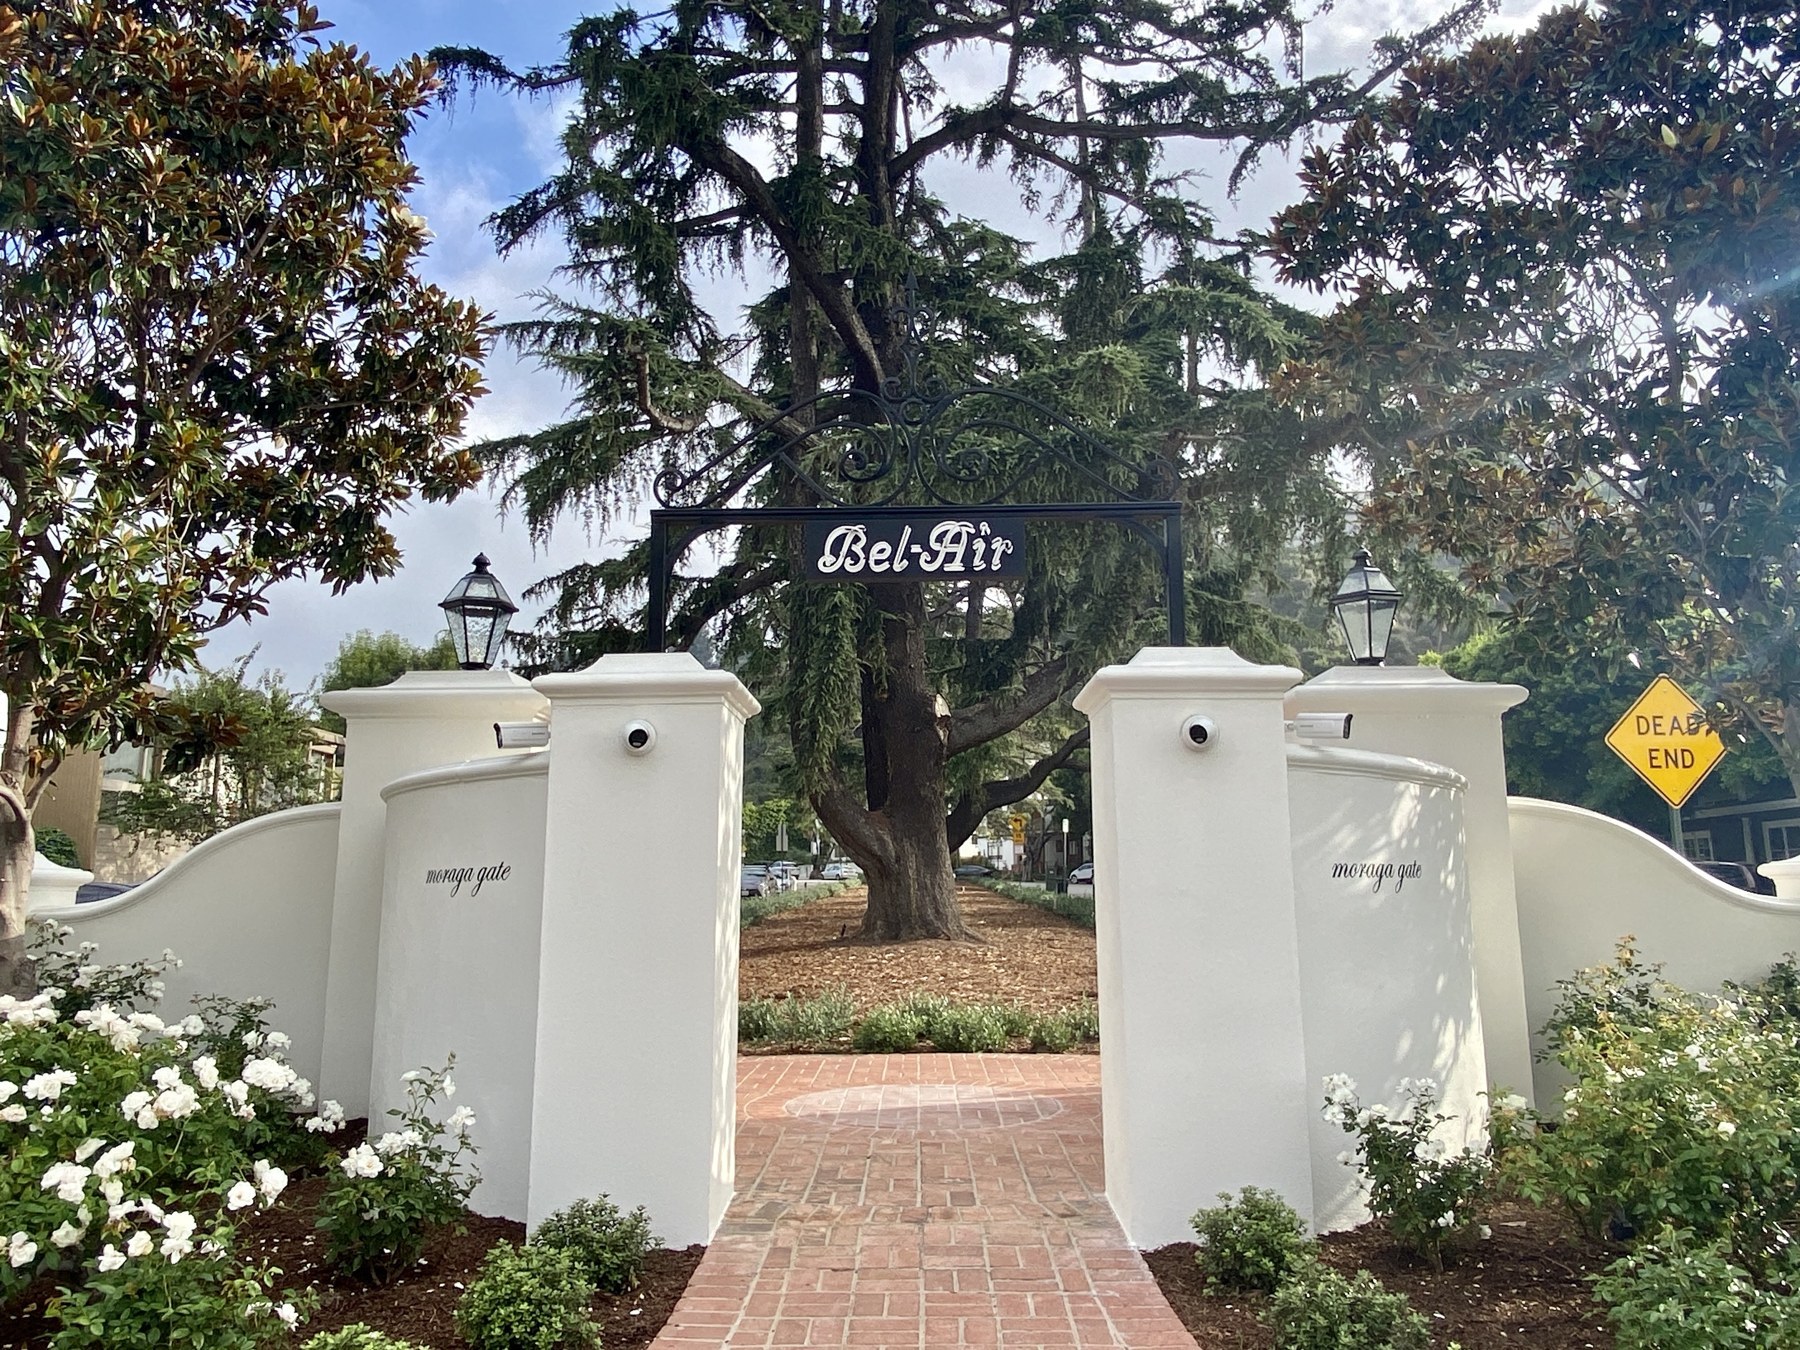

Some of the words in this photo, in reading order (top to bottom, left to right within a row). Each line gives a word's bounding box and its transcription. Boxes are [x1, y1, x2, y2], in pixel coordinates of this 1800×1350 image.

[817, 521, 1014, 573] Bel-Air
[1636, 715, 1700, 736] DEAD
[1648, 748, 1695, 769] END
[426, 867, 474, 898] moraga
[471, 861, 512, 897] gate
[1332, 862, 1395, 894] moraga
[1395, 859, 1422, 894] gate
